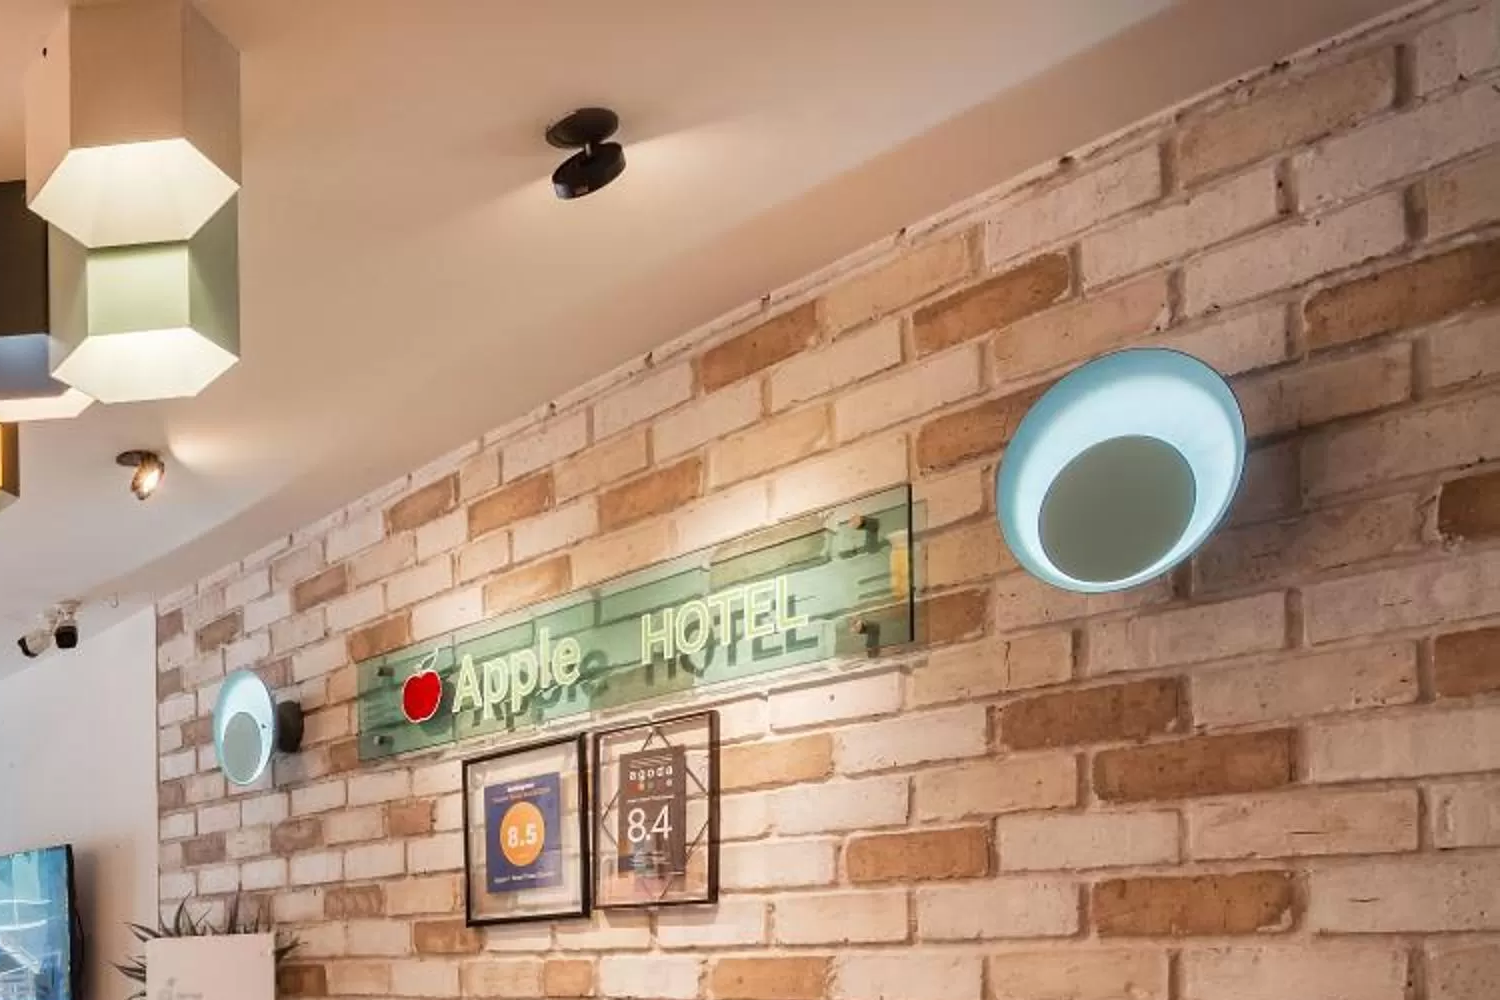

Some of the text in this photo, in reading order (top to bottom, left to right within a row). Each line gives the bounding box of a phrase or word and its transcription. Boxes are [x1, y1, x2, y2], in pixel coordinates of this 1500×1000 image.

[452, 575, 809, 721] Apple HOTEL
[628, 765, 673, 781] agoda
[507, 823, 537, 849] 8.5
[627, 804, 673, 843] 8.4
